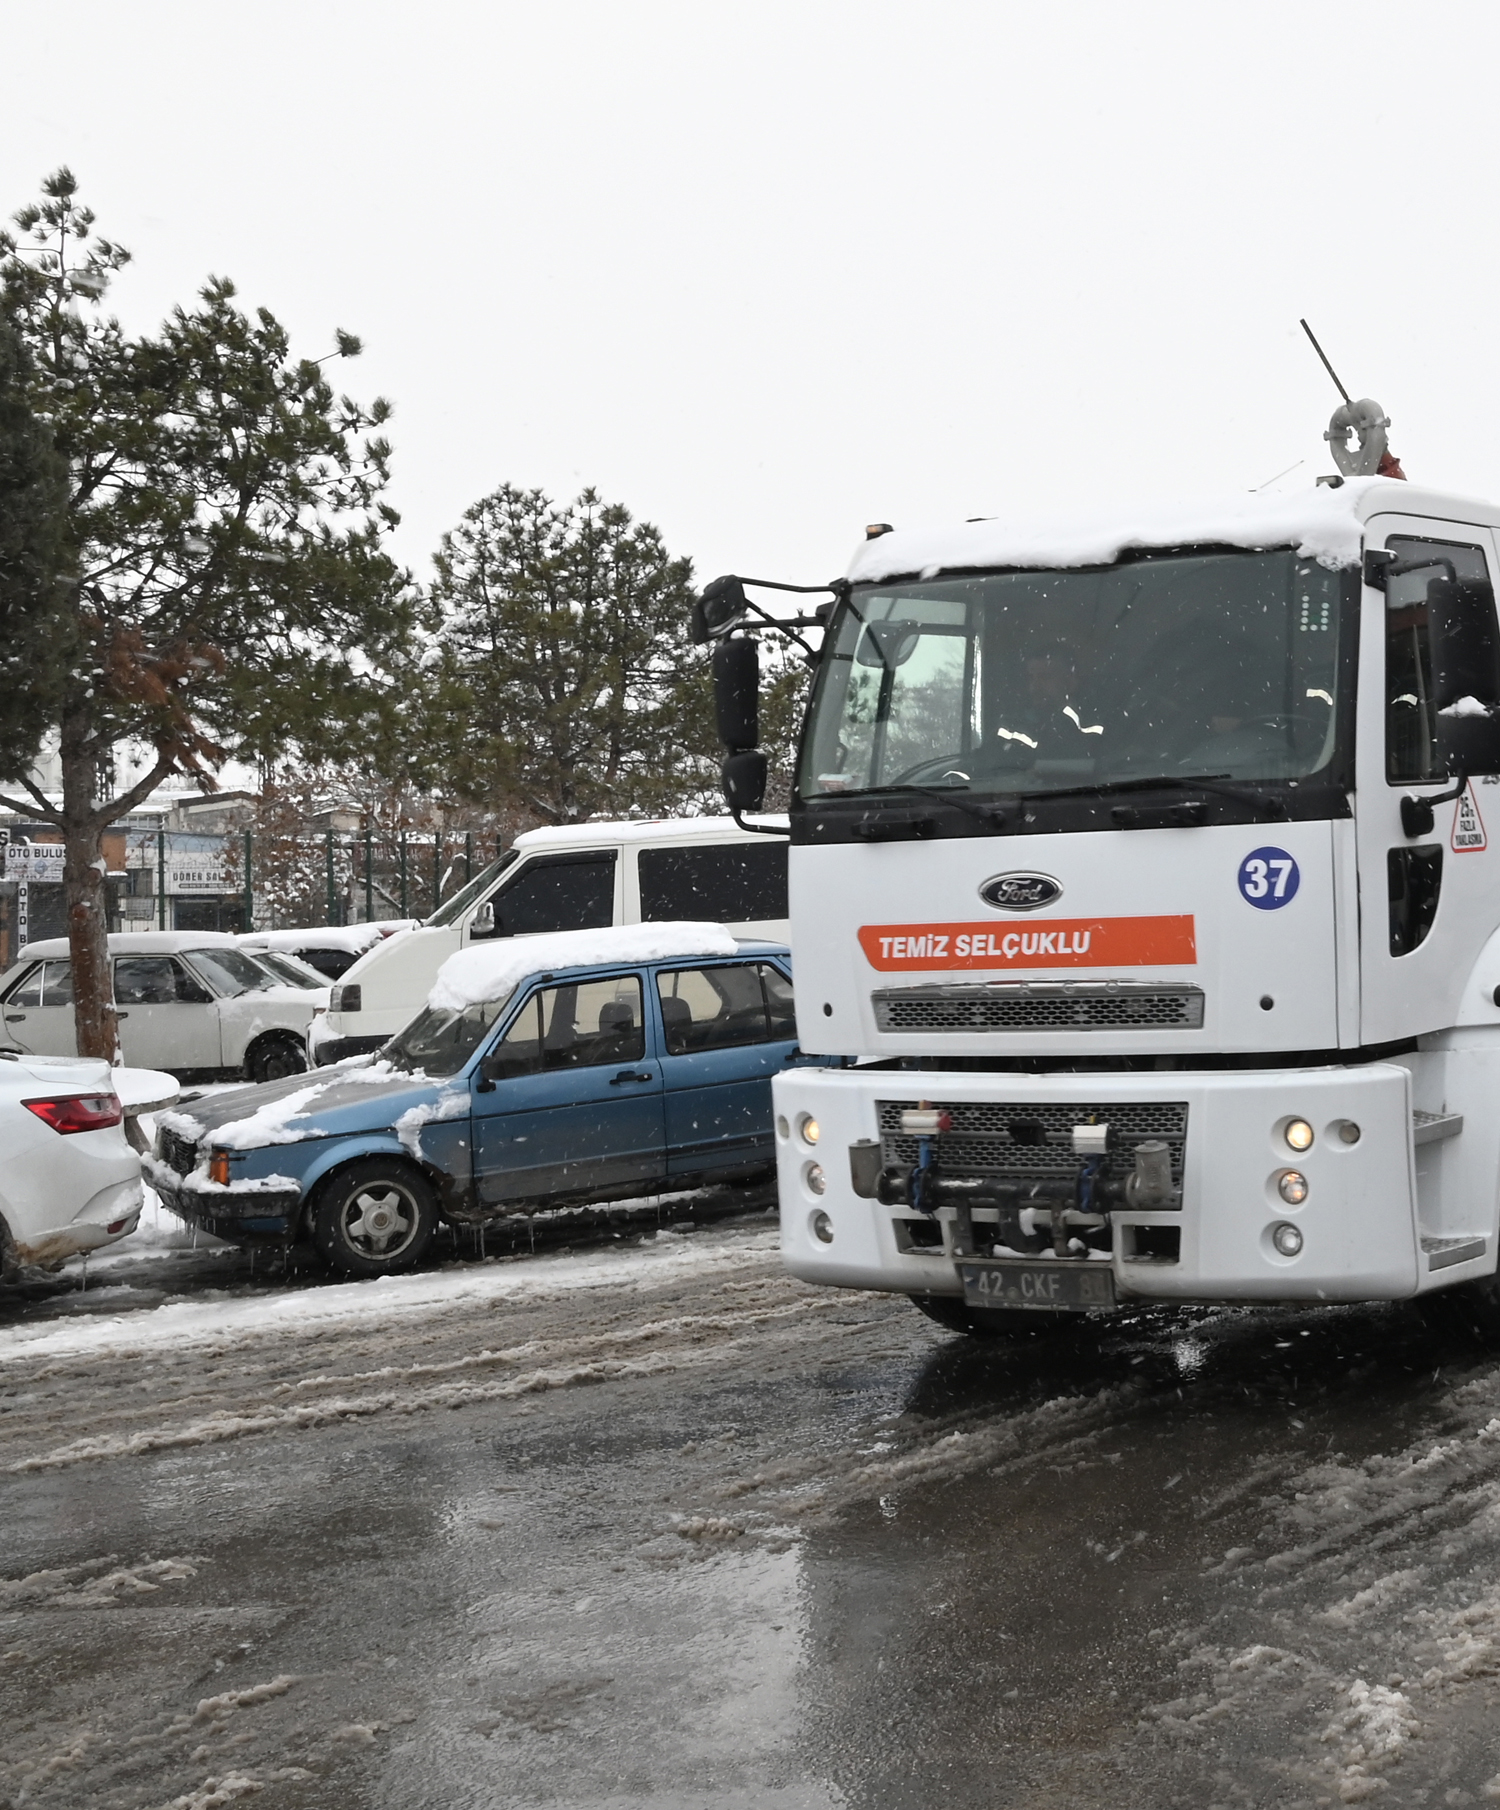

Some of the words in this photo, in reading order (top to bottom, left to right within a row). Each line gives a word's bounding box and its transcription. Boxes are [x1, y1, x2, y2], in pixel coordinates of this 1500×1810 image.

[9, 848, 30, 858] OTO
[997, 879, 1043, 902] Ford
[1245, 858, 1293, 898] 37
[954, 931, 1091, 959] SELÇUKLU
[978, 1271, 1004, 1297] 42
[1021, 1273, 1060, 1298] CKF
